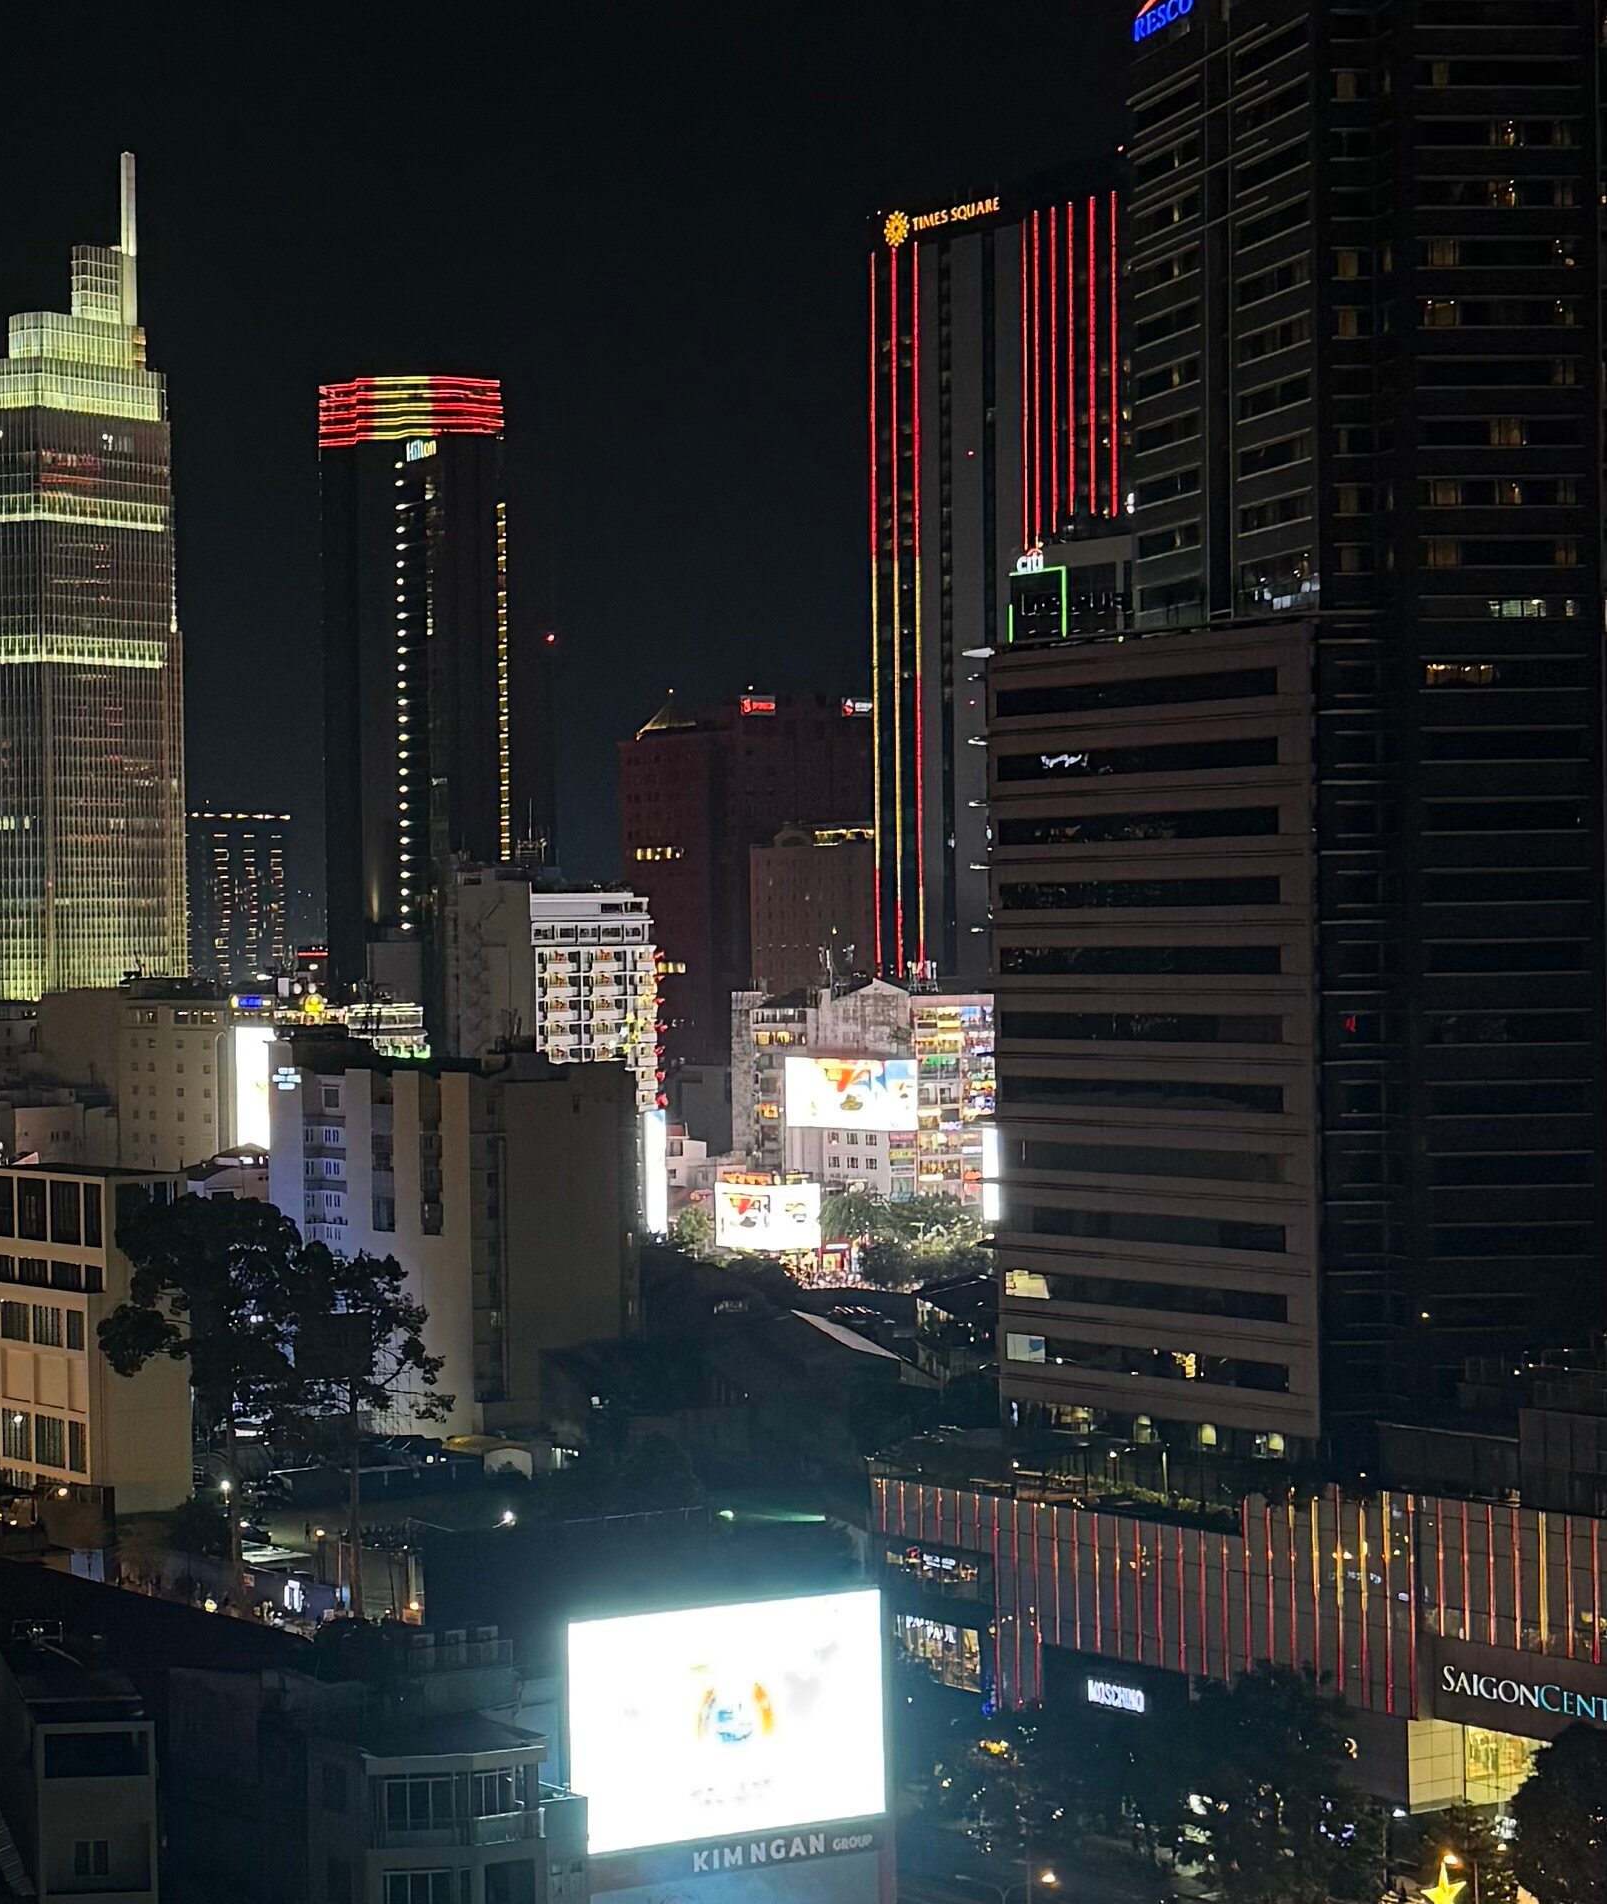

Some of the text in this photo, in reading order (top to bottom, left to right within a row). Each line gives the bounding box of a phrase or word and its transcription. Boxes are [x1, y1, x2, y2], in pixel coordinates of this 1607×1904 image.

[911, 195, 1002, 232] TIMES SQUARE
[693, 1833, 873, 1873] KIM NGAN GROUP
